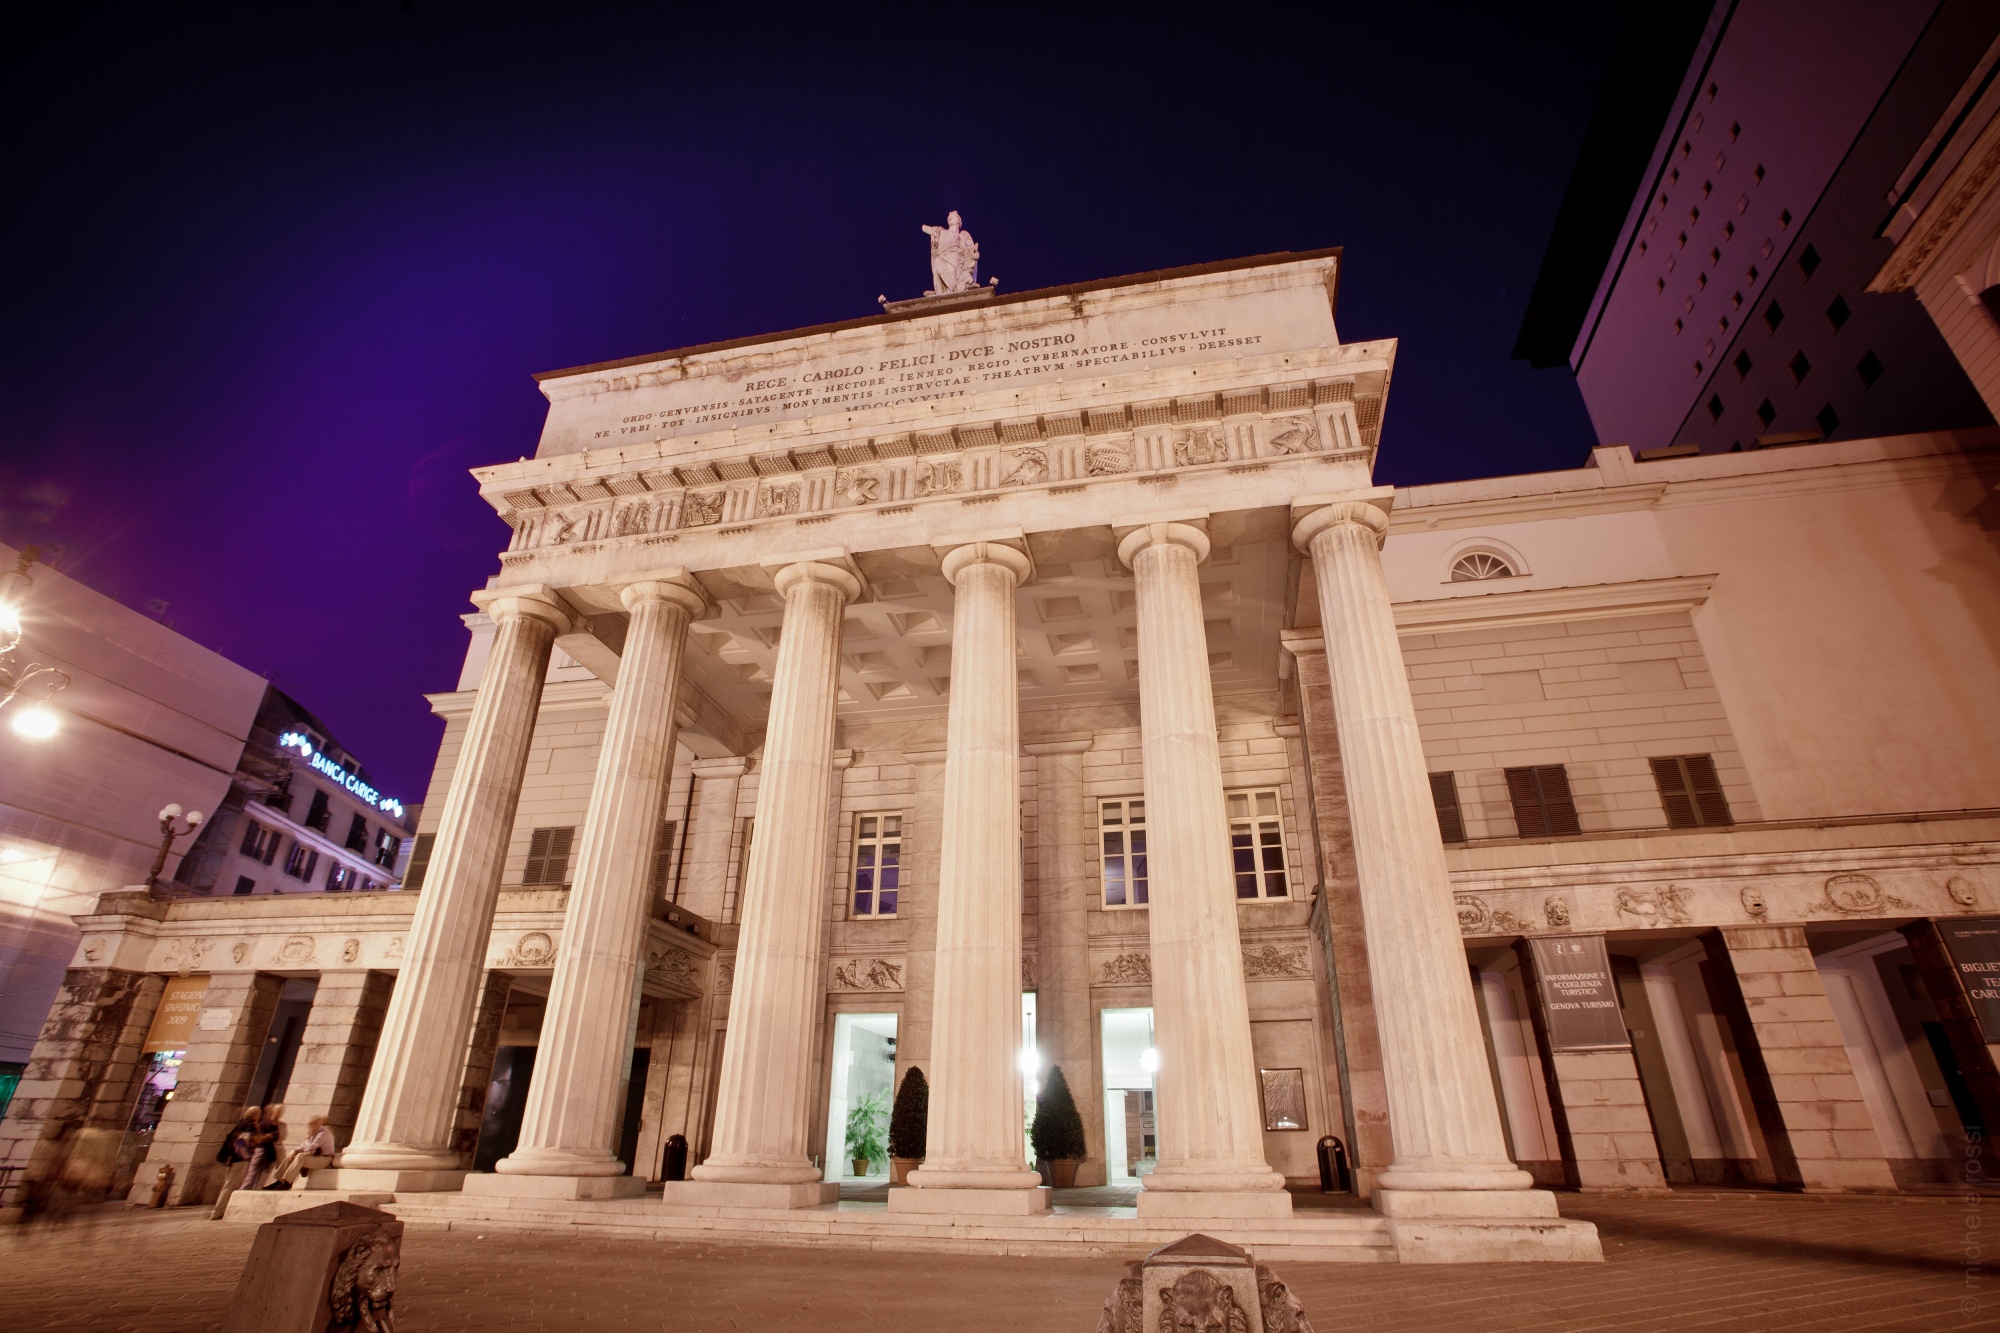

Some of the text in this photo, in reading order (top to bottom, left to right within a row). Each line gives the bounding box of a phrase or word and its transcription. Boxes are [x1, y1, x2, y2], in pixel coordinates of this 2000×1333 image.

[745, 334, 1076, 392] REGE CAROLO FELICI DVCE NOSTRO
[623, 328, 1226, 424] ORDO GENVENSIS SATAGENTE HECTORE IENNEO REGIO GVBERNATORE CONSVLVIT
[594, 335, 1262, 439] NE VRBI TOT INSIGNIBVS MONVMENTIS INSTRVCTAE THEATRVM SPECTABILIVS DEESSET
[311, 752, 379, 806] BANCA CARIGE
[1545, 972, 1599, 981] INFORMAZIONE
[1553, 980, 1602, 988] ACCOGLIENZA
[1560, 988, 1598, 996] TURISTICA
[1550, 1001, 1615, 1010] GENOVA TURISMO
[166, 1015, 188, 1025] 2009
